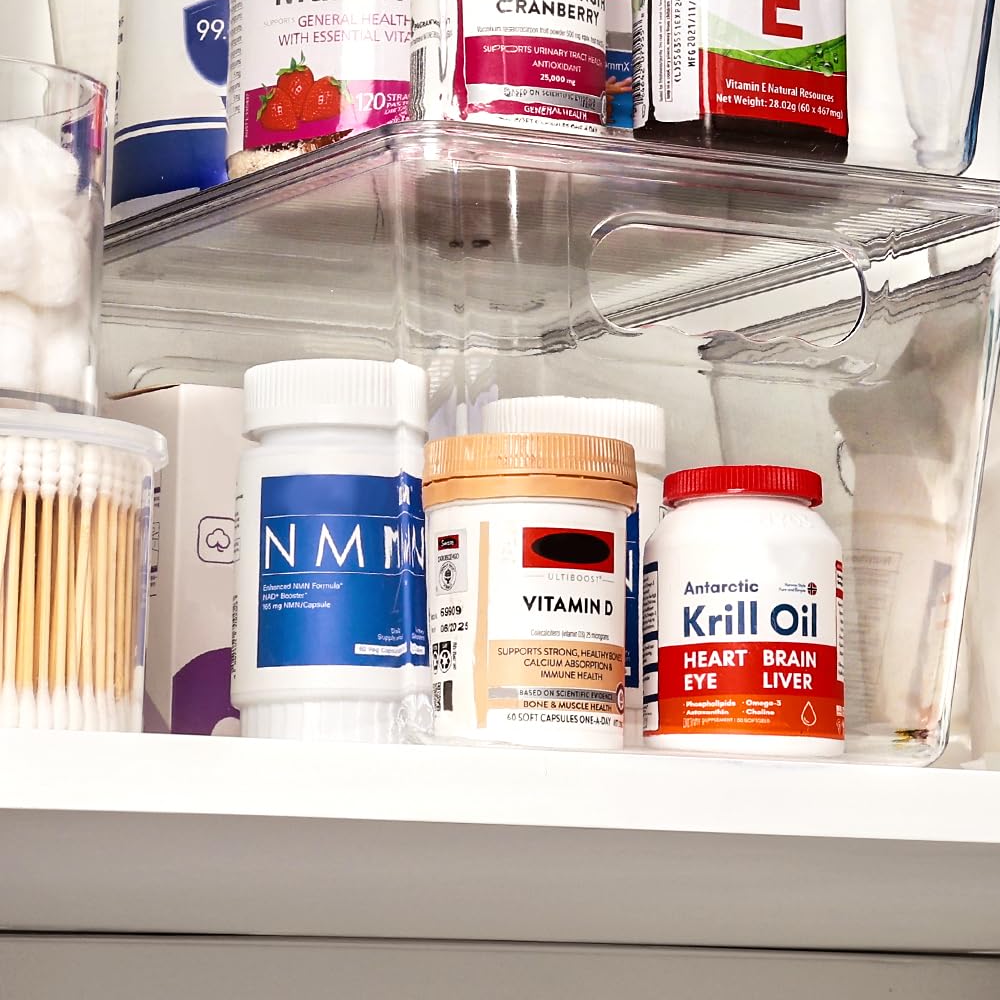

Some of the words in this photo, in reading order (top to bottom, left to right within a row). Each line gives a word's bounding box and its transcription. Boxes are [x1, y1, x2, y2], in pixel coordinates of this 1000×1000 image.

[496, 0, 599, 25] CRANBERRY
[298, 14, 357, 28] GENERAL
[362, 13, 411, 26] HEALTH
[278, 32, 308, 46] WITH
[313, 30, 381, 43] ESSENTIAL
[534, 46, 568, 58] URINARY
[569, 50, 587, 62] TRACT
[532, 60, 582, 72] ANTIOXIDANT
[540, 74, 566, 84] 25,000
[566, 78, 576, 86] mg
[726, 78, 760, 92] Vitamin
[762, 82, 767, 93] E
[768, 84, 798, 97] Natural
[800, 88, 834, 103] Resources
[356, 92, 386, 112] 120
[716, 94, 732, 104] Net
[733, 95, 768, 108] Weight:
[769, 99, 796, 113] 28.02g
[798, 102, 811, 114] (60
[817, 104, 844, 119] 467mg)
[262, 583, 292, 592] Enhanced
[292, 582, 310, 590] NMN
[684, 579, 758, 595] Antarctic
[284, 602, 331, 610] NMN/Capsule
[522, 596, 601, 615] VITAMIN
[604, 600, 614, 616] D
[684, 600, 758, 638] Krill
[770, 602, 817, 638] Oil
[498, 648, 542, 656] SUPPORTS
[544, 648, 580, 658] STRONG,
[581, 650, 608, 660] HEALTHY
[684, 650, 748, 669] HEART
[763, 650, 816, 668] BRAIN
[524, 658, 562, 667] CALCIUM
[564, 661, 608, 671] ABSORPTION
[540, 670, 576, 680] IMMUNE
[578, 672, 602, 680] HEALTH
[684, 672, 718, 692] EYE
[763, 672, 812, 690] LIVER
[556, 690, 590, 698] SCIENTIFIC
[524, 700, 548, 708] BONE
[558, 702, 588, 710] MUSCLE
[590, 703, 612, 712] HEALTH
[746, 700, 782, 708] Omega-3
[518, 713, 538, 722] SOFT
[540, 714, 578, 724] CAPSULES
[580, 715, 612, 726] ONE-A-DAY
